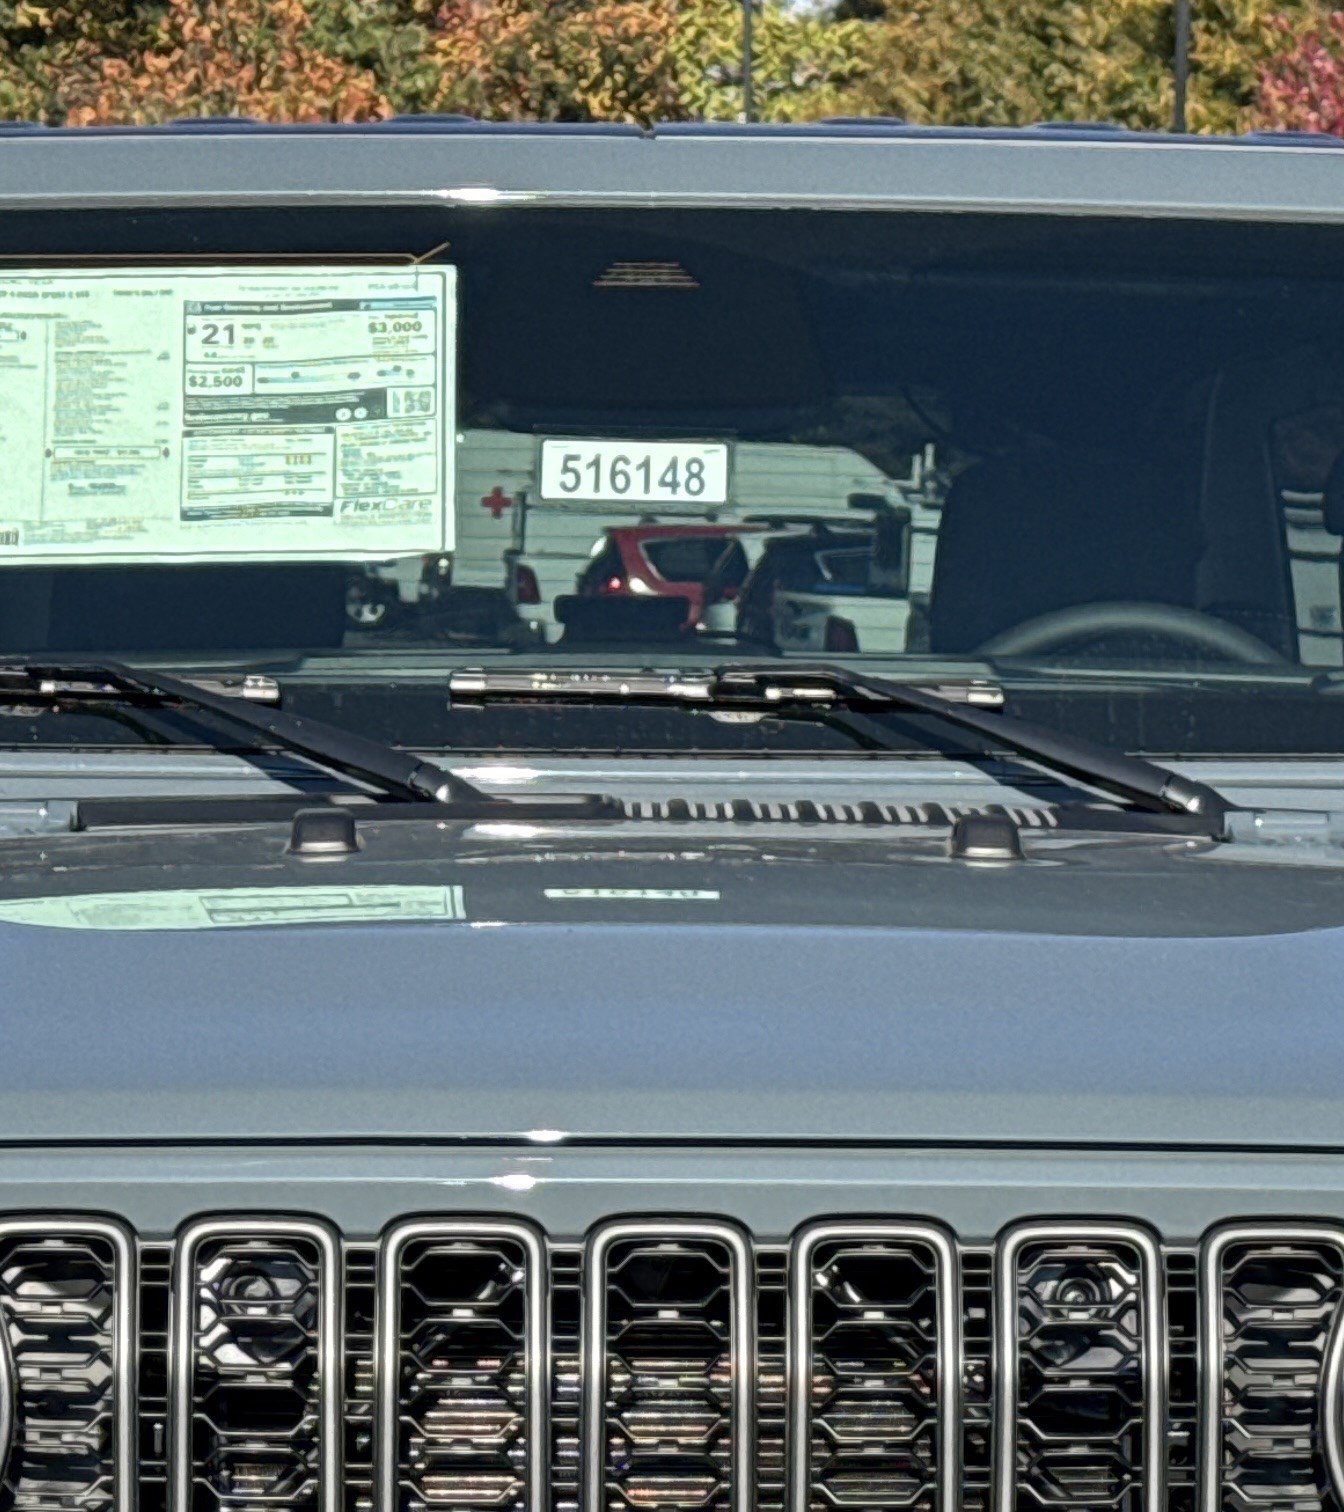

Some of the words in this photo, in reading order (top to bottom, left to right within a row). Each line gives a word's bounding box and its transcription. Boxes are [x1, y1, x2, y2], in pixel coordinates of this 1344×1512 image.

[201, 323, 235, 346] 21
[367, 321, 423, 335] $3,000
[188, 375, 243, 388] $2,500
[559, 453, 706, 497] 516148
